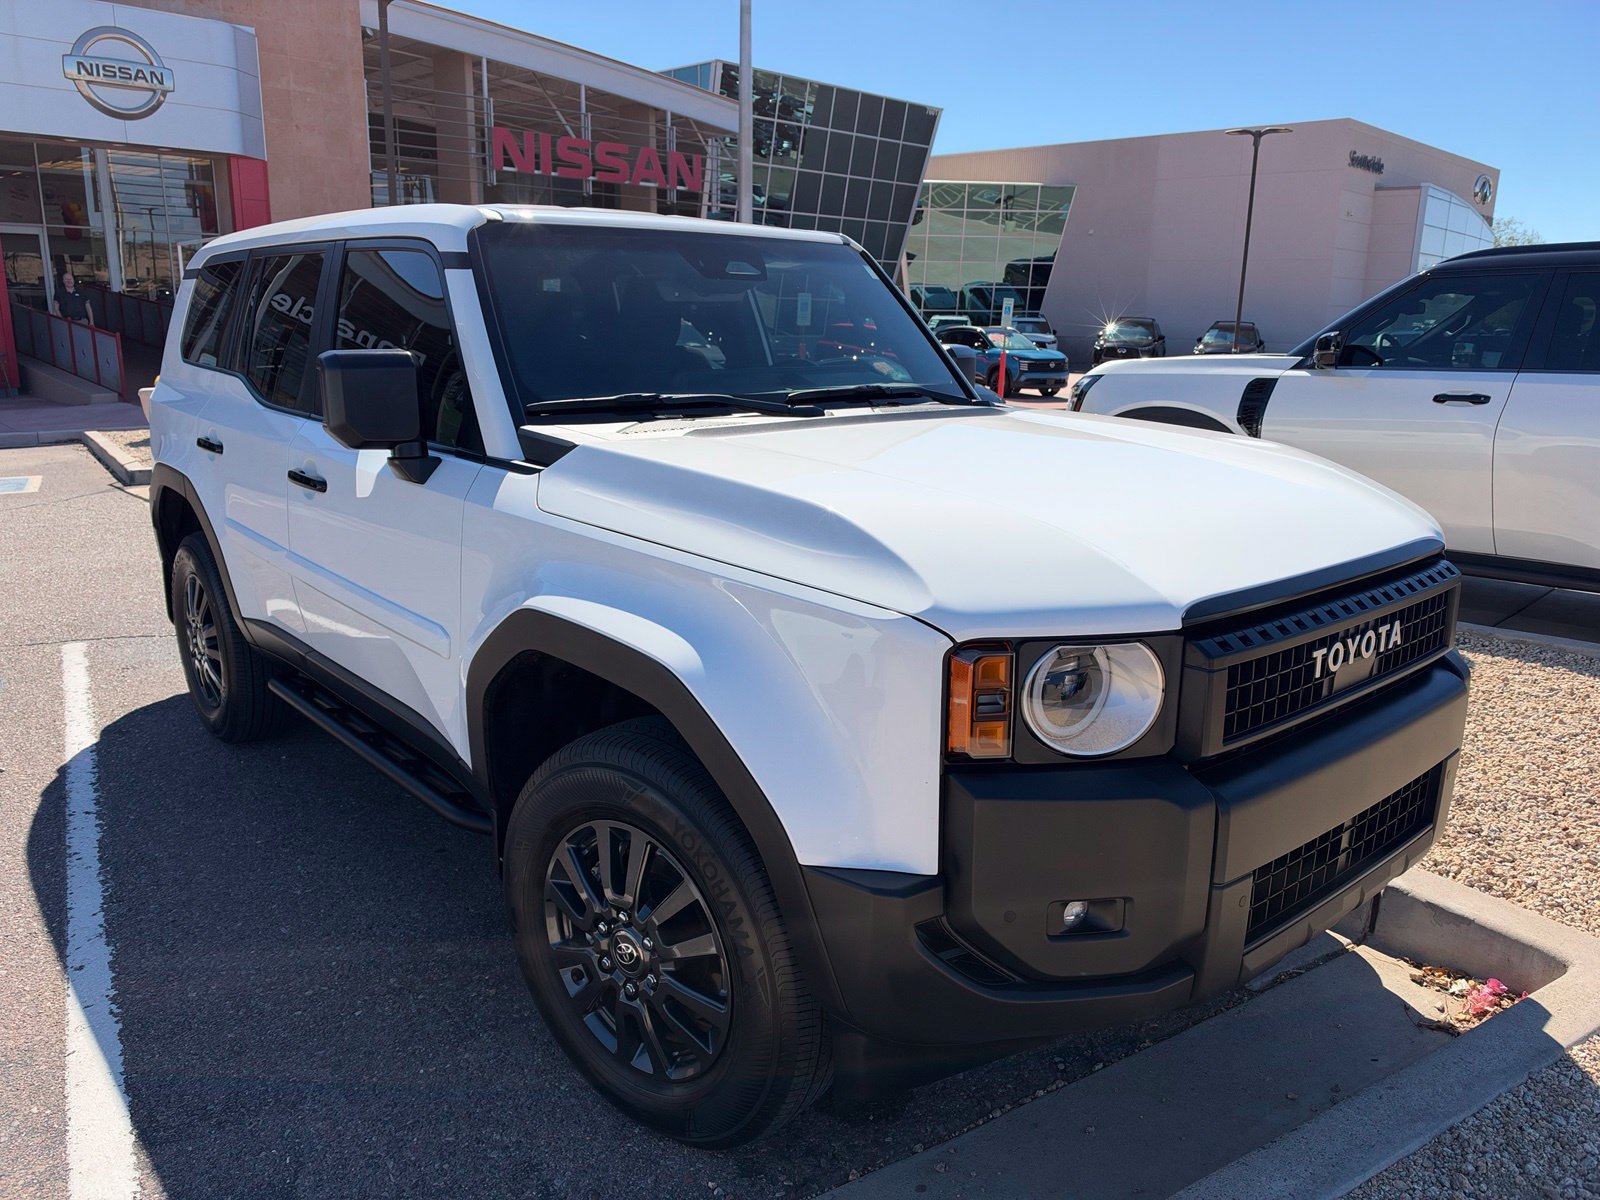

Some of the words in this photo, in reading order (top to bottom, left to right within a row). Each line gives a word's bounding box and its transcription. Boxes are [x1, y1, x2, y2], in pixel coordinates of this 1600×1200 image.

[76, 60, 165, 86] NISSAN
[492, 126, 703, 192] NISSAN
[1311, 619, 1402, 679] TOYOTA
[670, 816, 755, 958] YOKOHAMA
